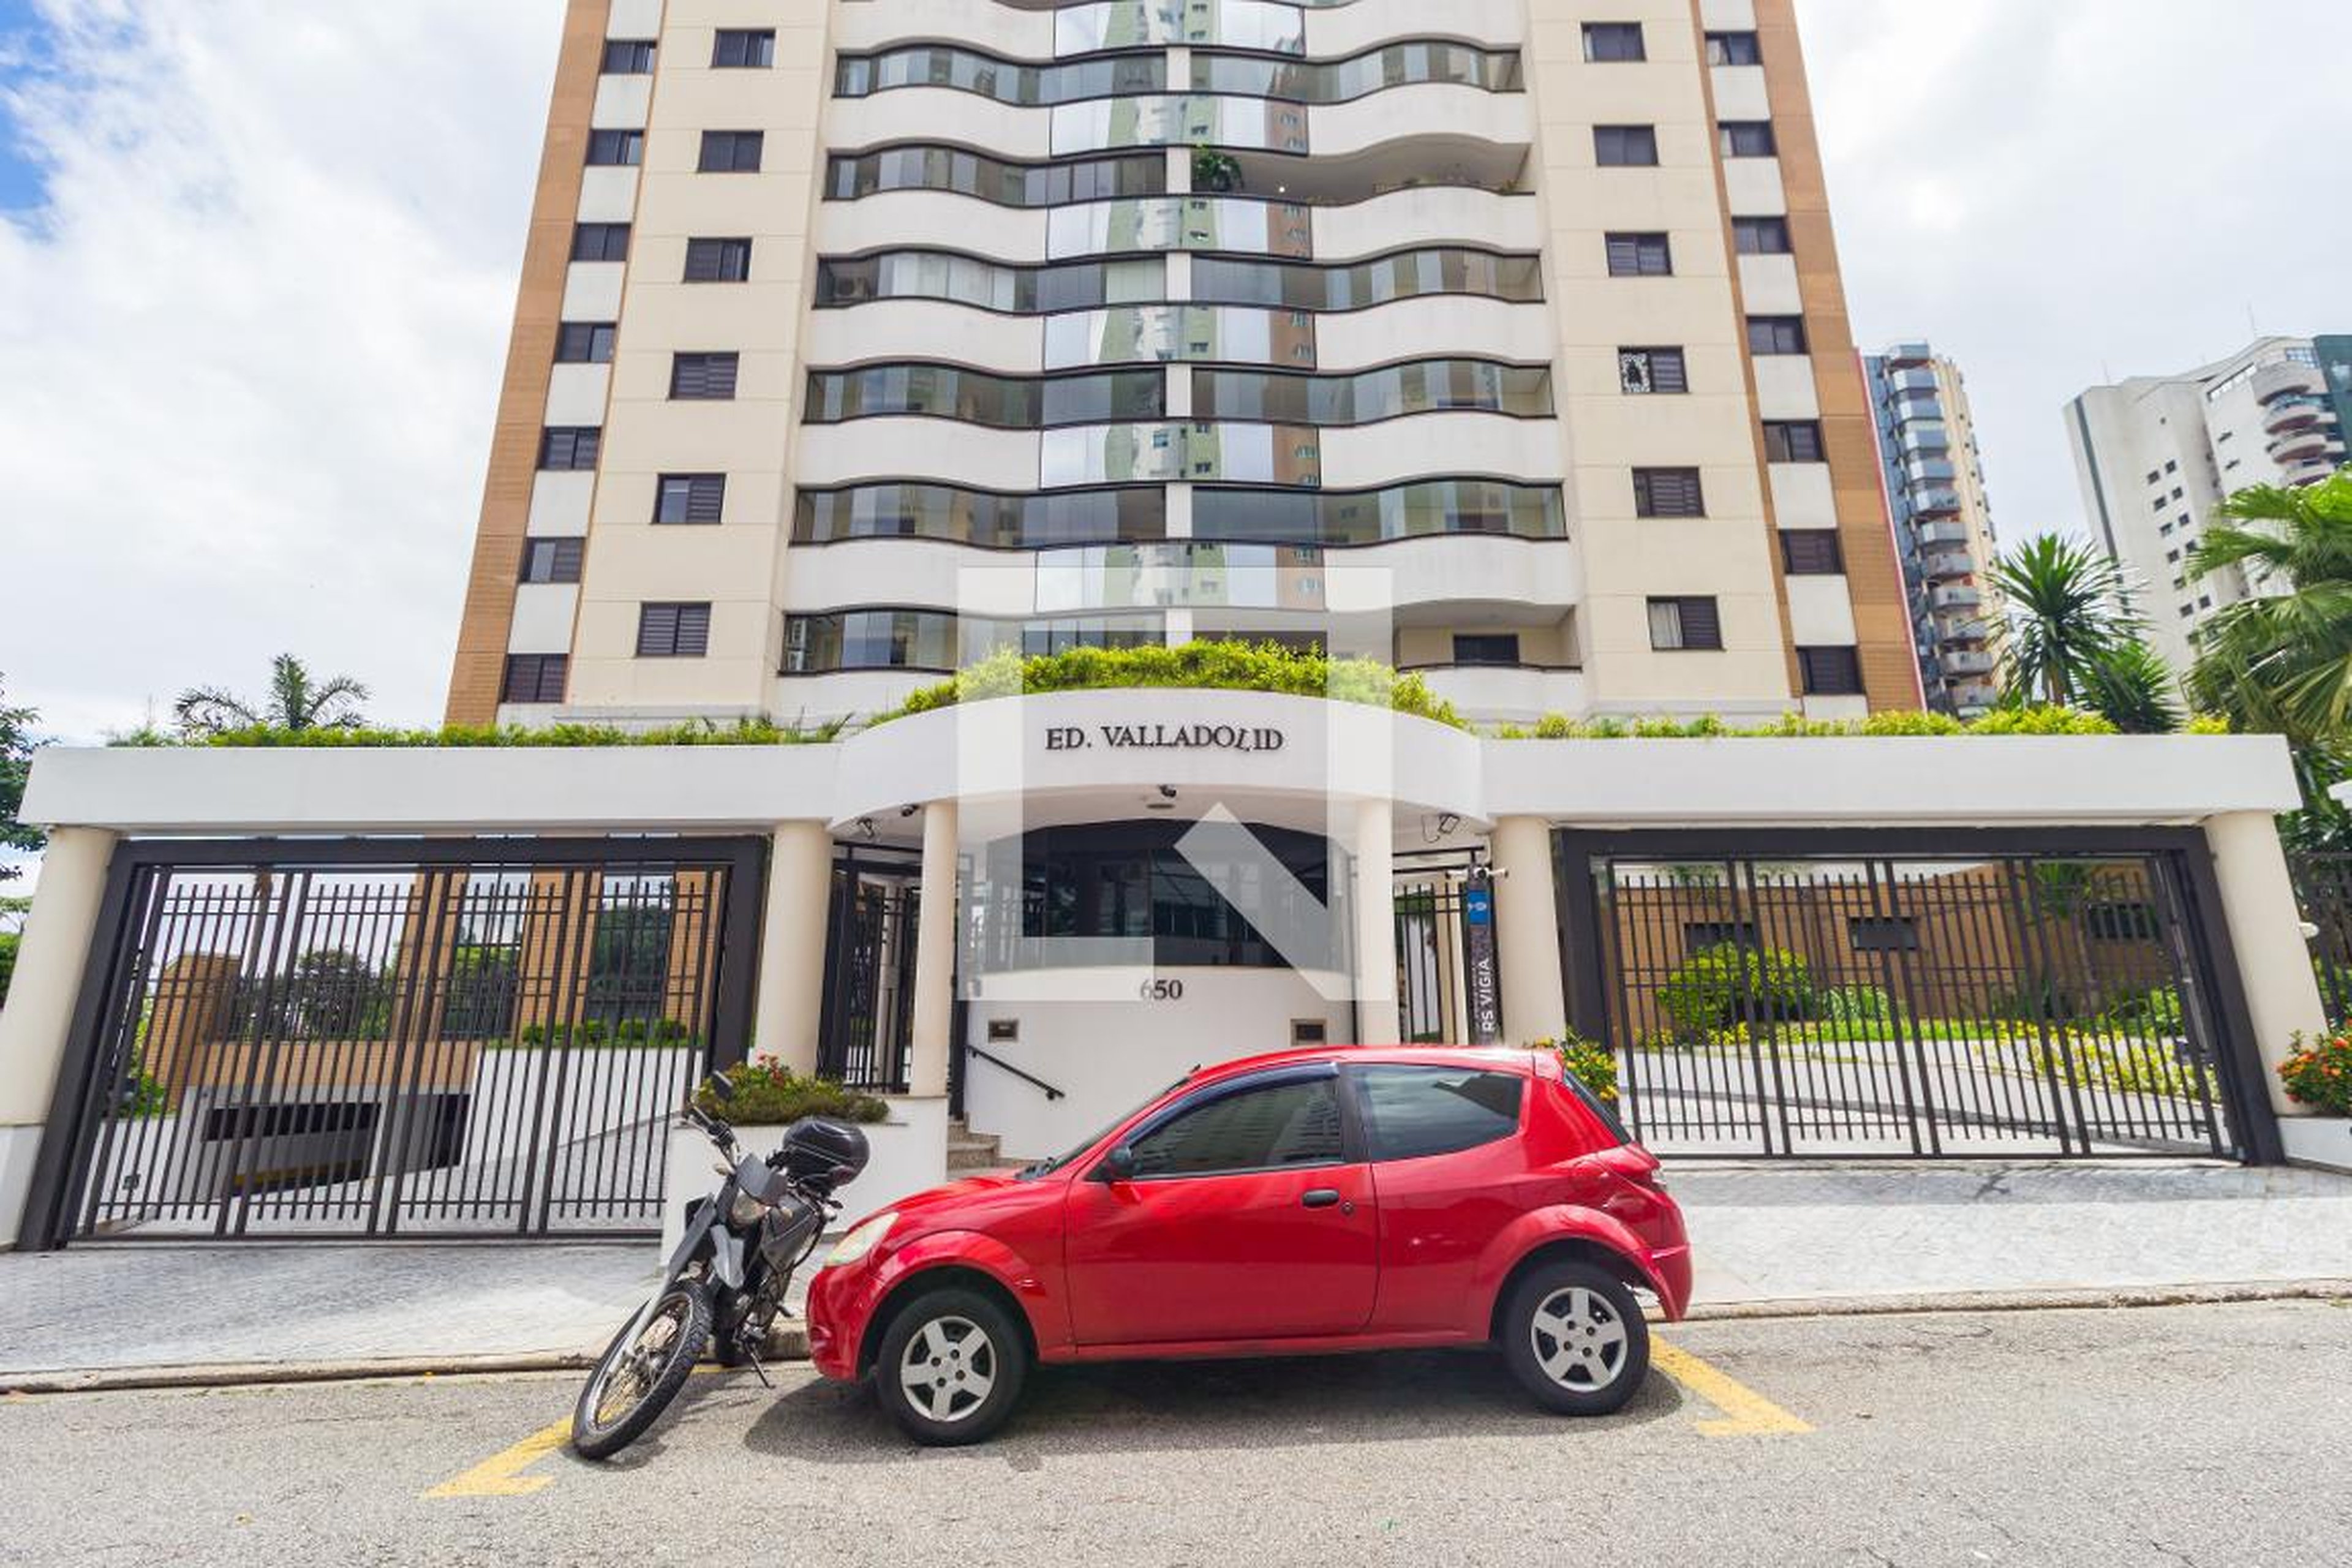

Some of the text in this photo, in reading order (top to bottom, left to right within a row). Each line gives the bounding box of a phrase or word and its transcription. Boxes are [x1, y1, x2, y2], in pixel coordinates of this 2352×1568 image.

[1045, 725, 1284, 752] ED. VALLADOLID
[1140, 979, 1183, 1000] 650
[1479, 958, 1493, 1004] VIGIA
